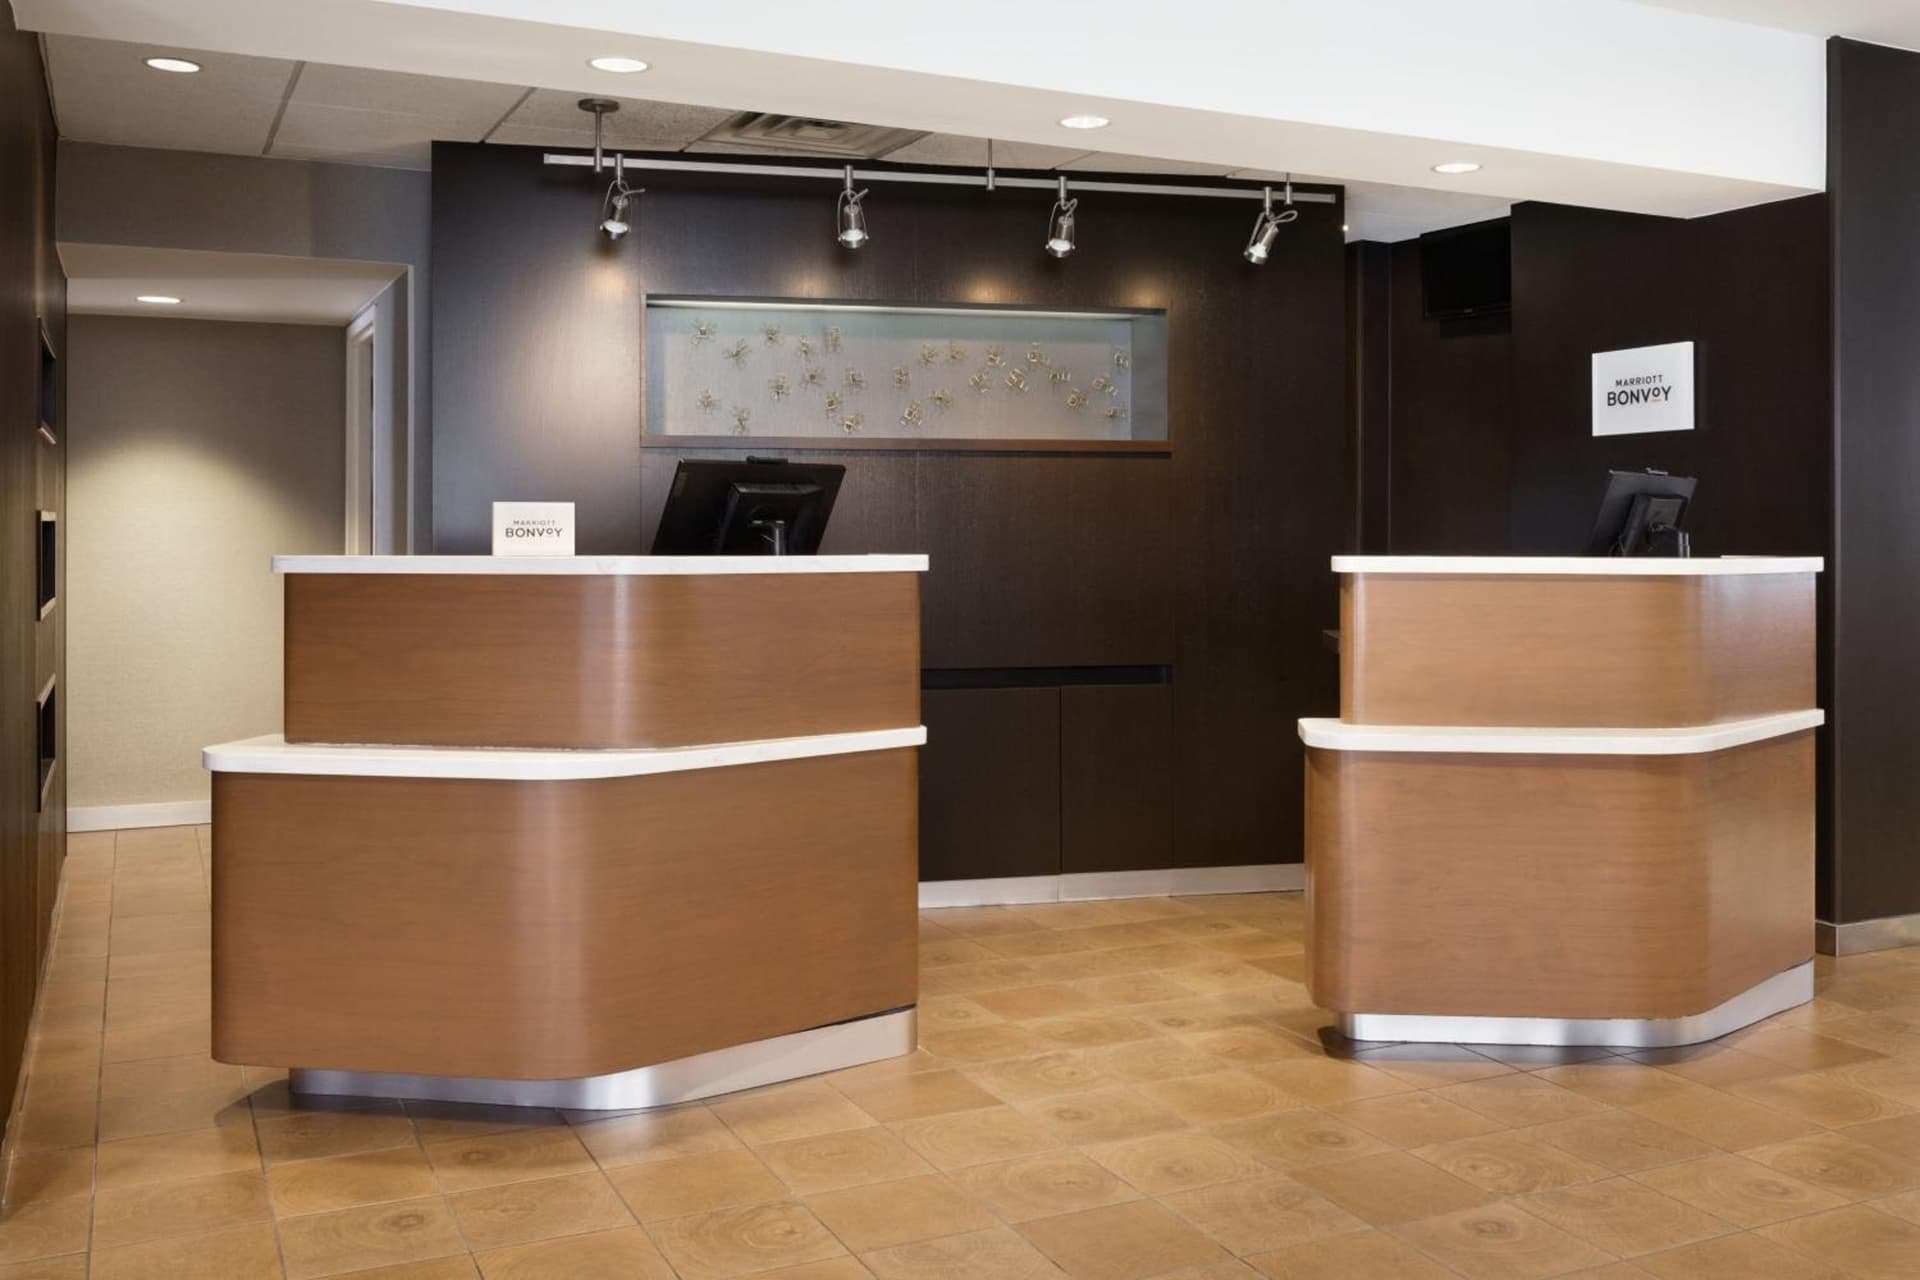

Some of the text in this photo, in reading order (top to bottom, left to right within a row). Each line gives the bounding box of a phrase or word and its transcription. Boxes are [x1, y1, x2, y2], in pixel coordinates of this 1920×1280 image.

[1615, 374, 1663, 387] MARRIOTT
[1607, 385, 1671, 406] BONVOY
[505, 527, 563, 538] BONVOY
